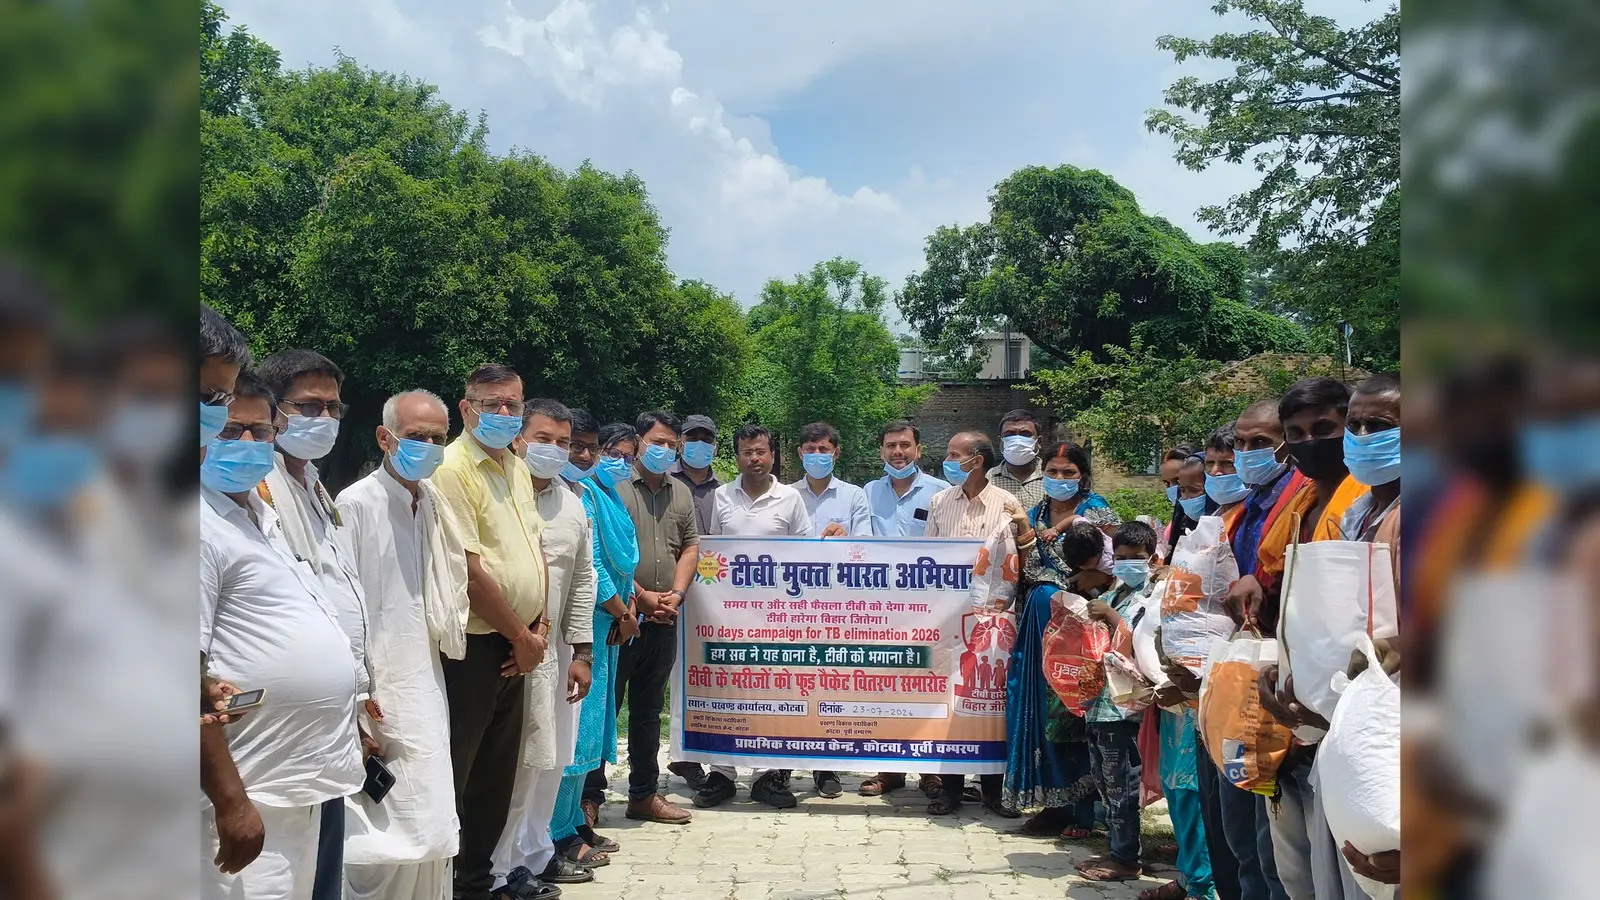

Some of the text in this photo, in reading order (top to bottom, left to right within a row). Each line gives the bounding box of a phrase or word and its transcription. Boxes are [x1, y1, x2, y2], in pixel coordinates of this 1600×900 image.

[730, 554, 777, 587] टीबी
[781, 562, 831, 597] मुक्त
[836, 562, 890, 589] भारत
[895, 556, 974, 590] अभिया
[723, 598, 931, 614] समय पर और सही फैसला टीबी को देगा मात,
[766, 611, 889, 625] टीबी हारेगा बिहार जितेगा।
[695, 625, 940, 641] 100 days campaign for TB elimination 2026
[710, 645, 920, 665] हम सब ने यह ठाना है, टीबी को भगाना है।
[688, 665, 947, 697] टीबी के मरीजों को फूड पैकेट वितरण समारोह
[971, 689, 988, 698] टीबी
[688, 699, 804, 713] स्थान- प्रखण्ड कार्यालय, कोटवा
[819, 702, 845, 714] दिनांक-
[962, 699, 987, 711] बिहार
[735, 737, 783, 750] प्राथमिक
[786, 740, 825, 751] स्वास्थ्य
[828, 739, 859, 754] केन्द्र,
[863, 741, 906, 755] कोटवा,
[910, 741, 933, 757] पूर्वी
